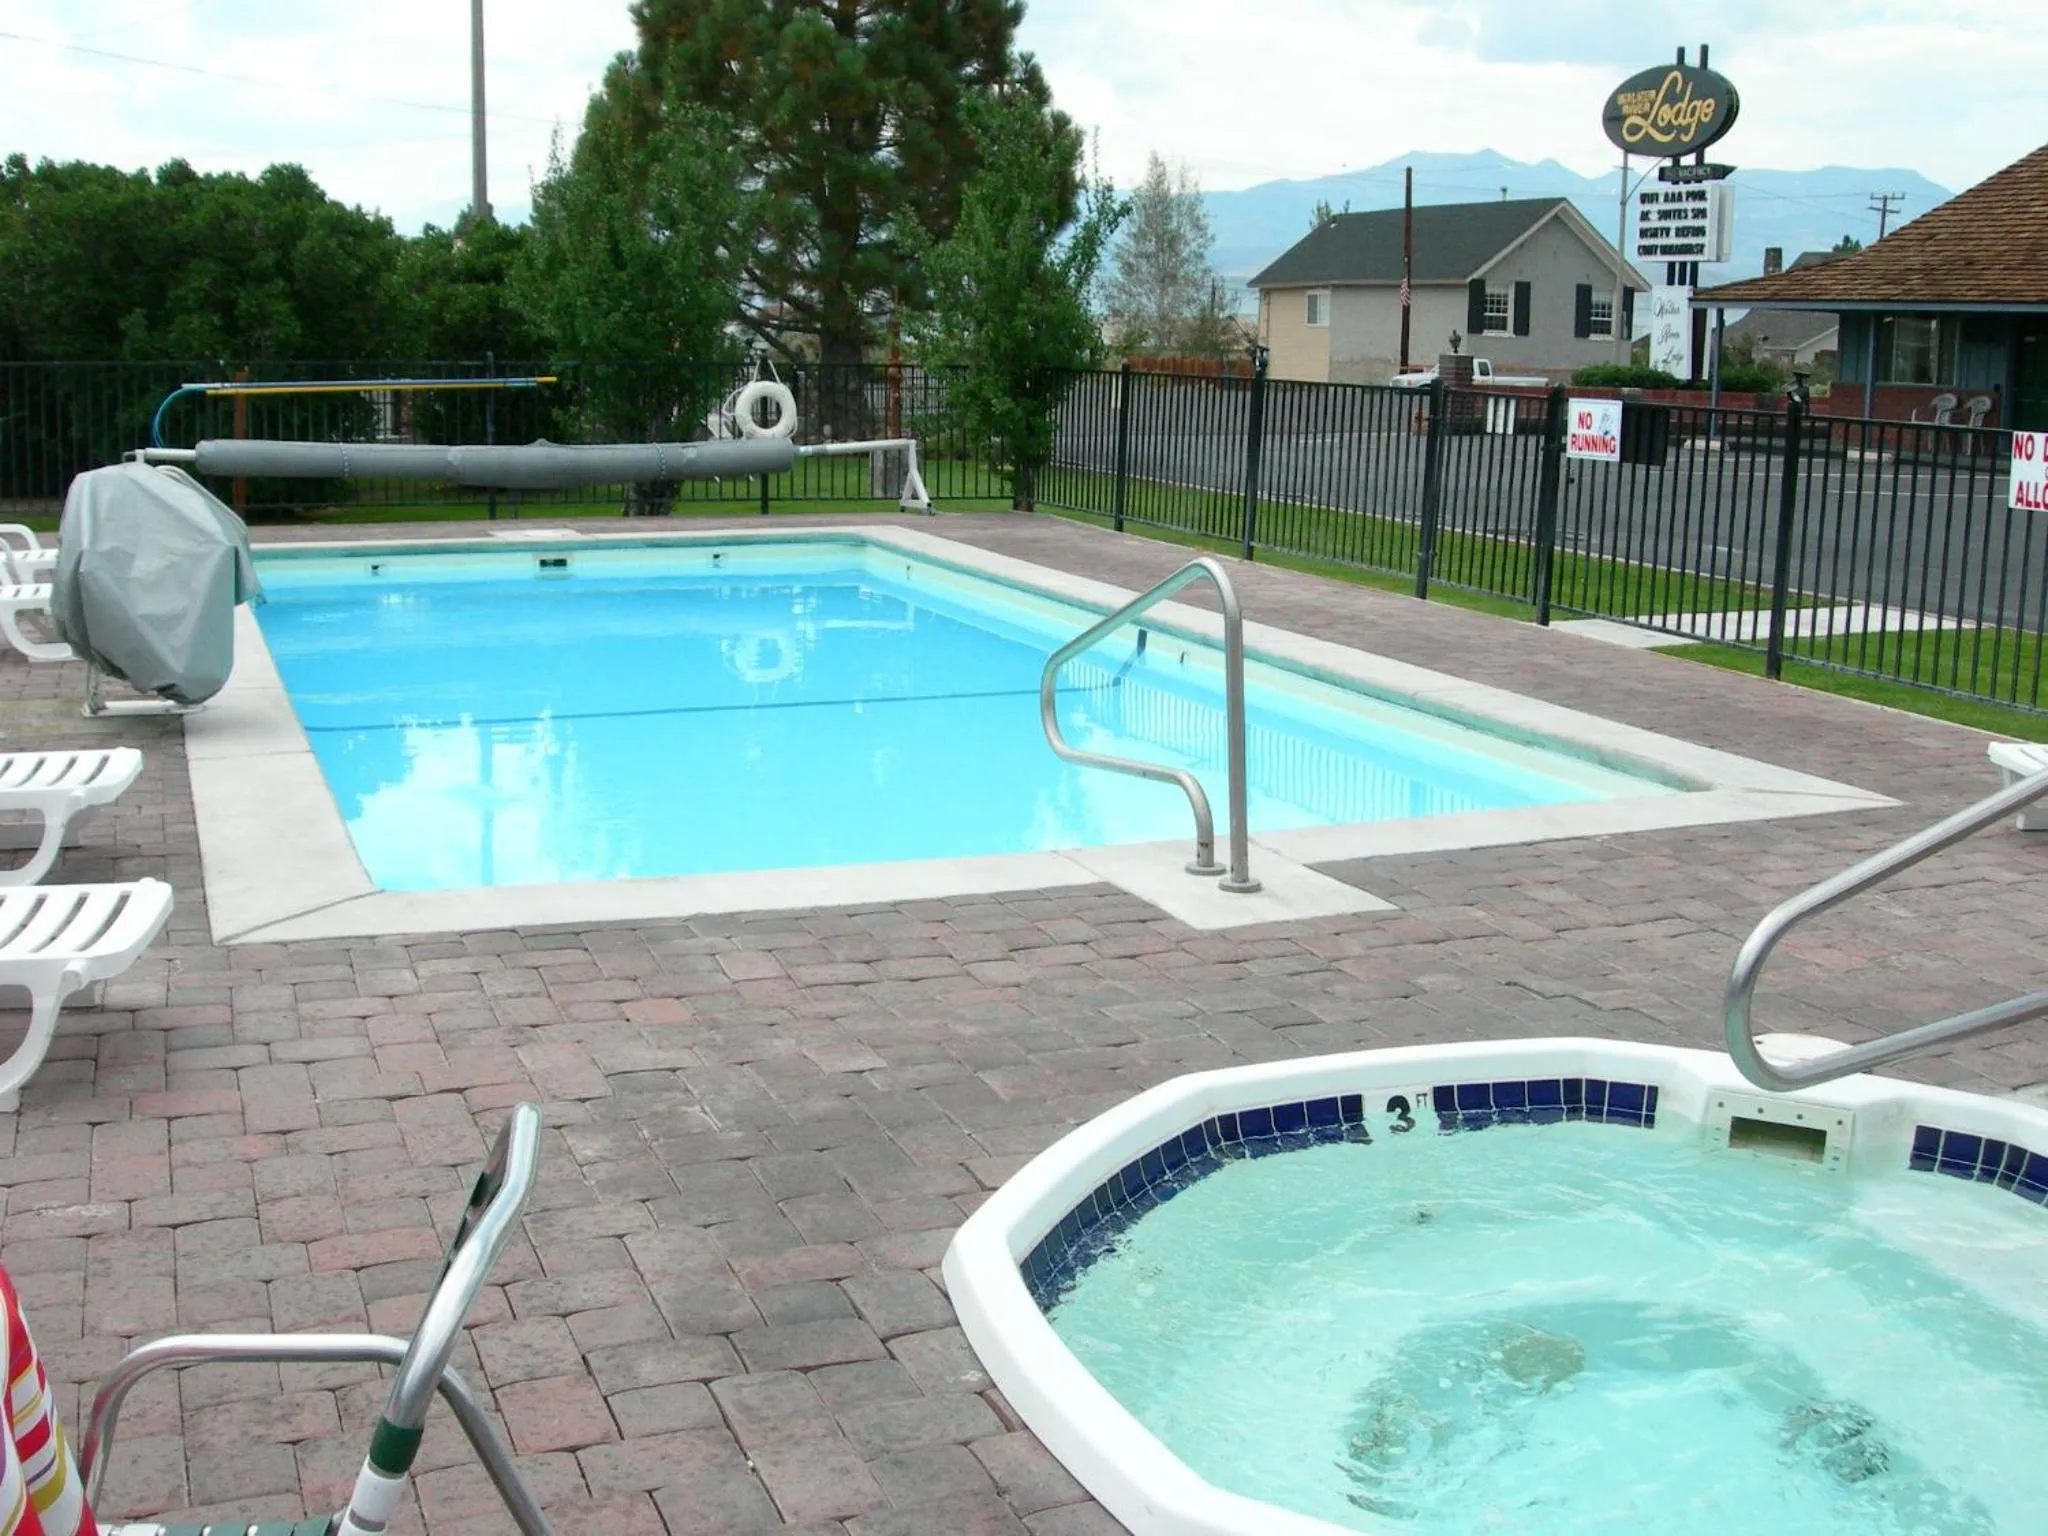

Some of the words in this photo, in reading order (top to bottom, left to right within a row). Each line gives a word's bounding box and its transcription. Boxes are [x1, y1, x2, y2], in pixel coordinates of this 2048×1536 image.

[1622, 70, 1716, 142] Lodge
[1657, 208, 1688, 221] SUITES
[1577, 411, 1593, 430] NO
[1571, 433, 1616, 453] RUNNING
[2013, 433, 2035, 461] NO
[1386, 1095, 1416, 1133] 3
[1415, 1092, 1429, 1109] FT
